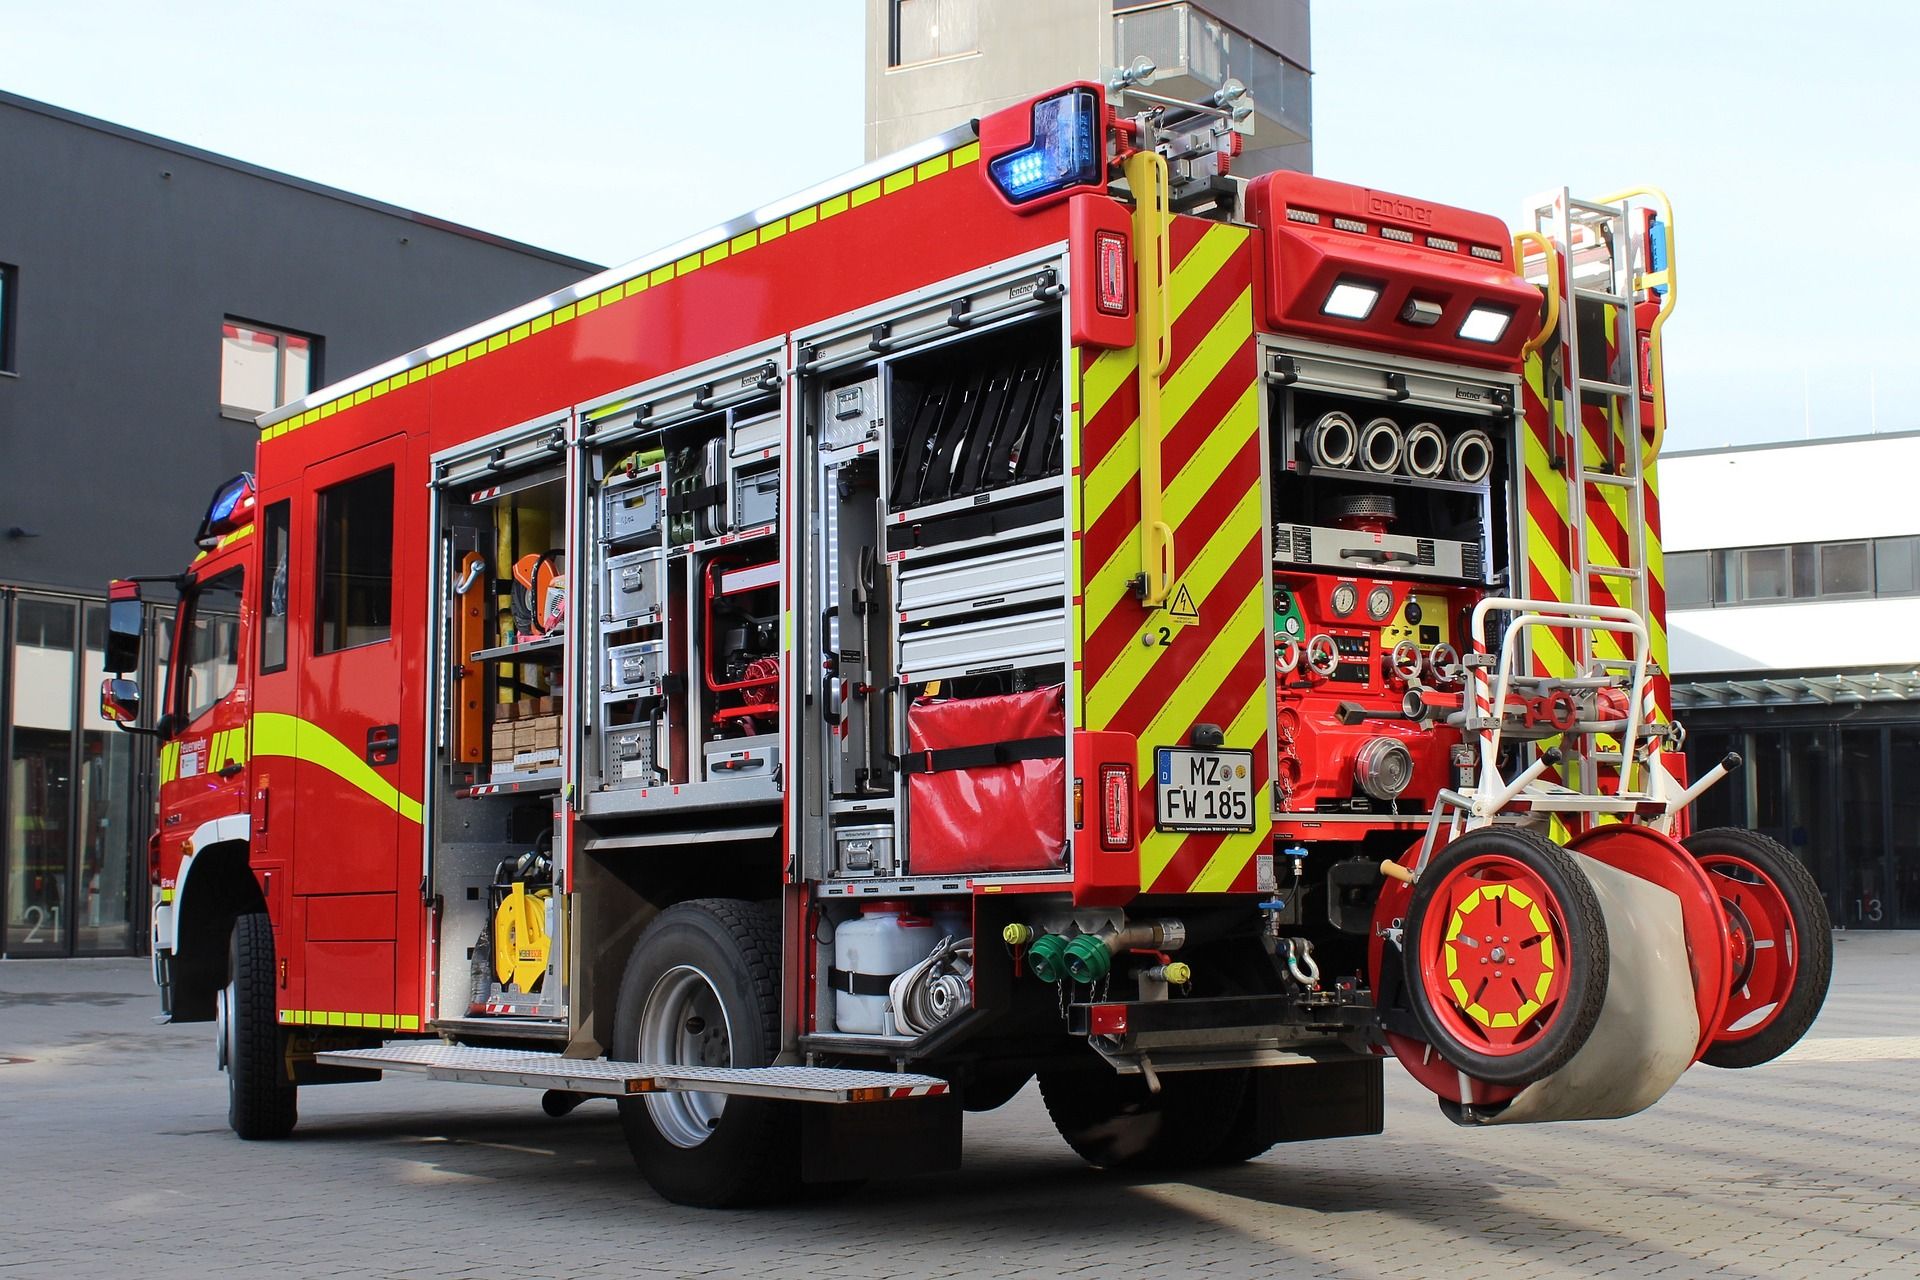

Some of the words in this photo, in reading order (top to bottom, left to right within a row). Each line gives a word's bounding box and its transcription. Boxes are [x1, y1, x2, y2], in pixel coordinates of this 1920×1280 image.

[818, 350, 826, 359] G5
[1159, 627, 1171, 646] 2
[180, 736, 207, 754] Feuerwehr
[1162, 772, 1168, 780] D
[1190, 757, 1221, 785] MZ
[1167, 789, 1197, 818] FW
[1204, 790, 1246, 820] 185
[1856, 899, 1883, 921] 13
[23, 905, 59, 943] 21
